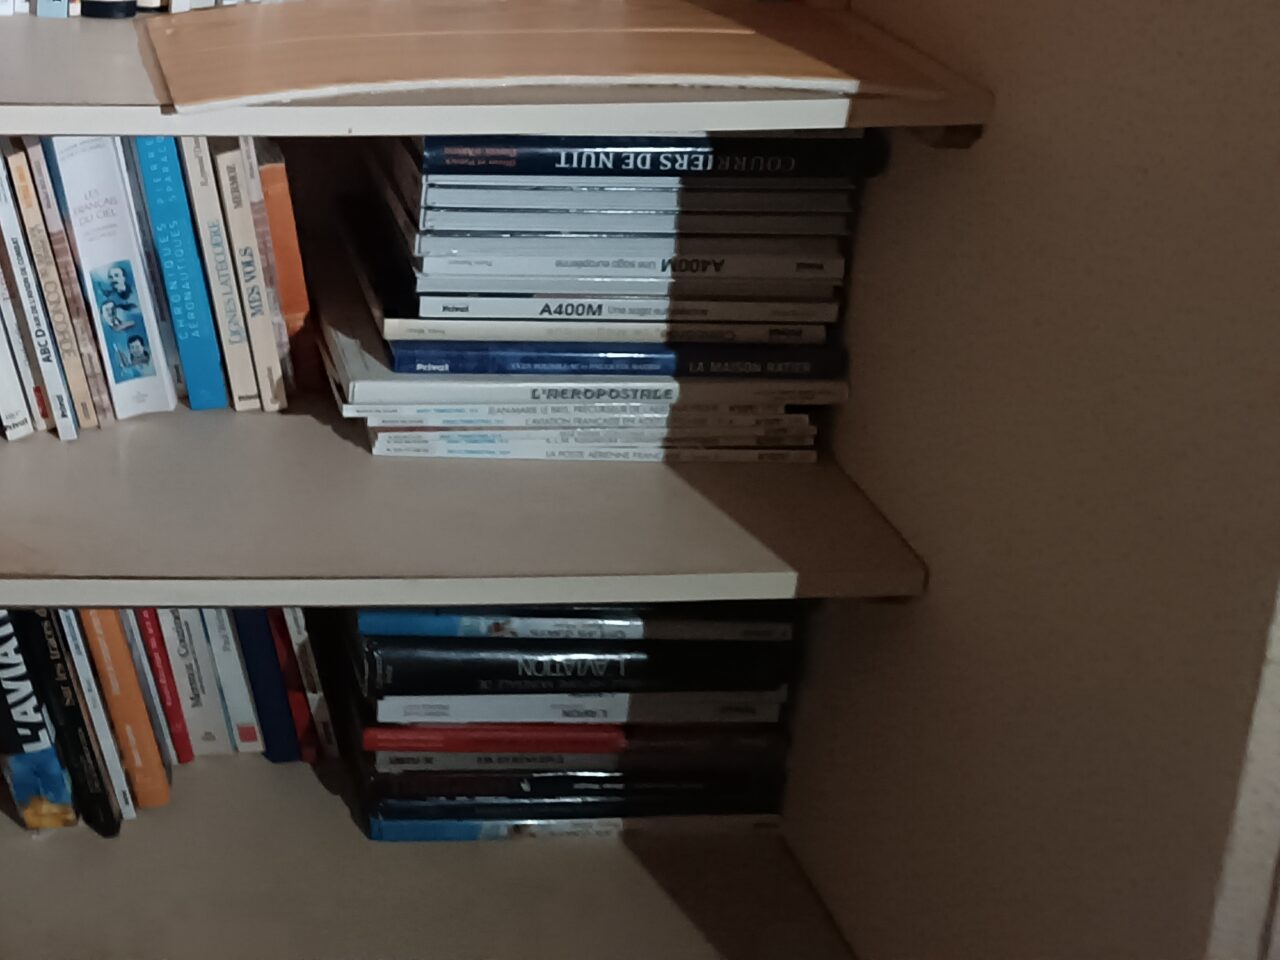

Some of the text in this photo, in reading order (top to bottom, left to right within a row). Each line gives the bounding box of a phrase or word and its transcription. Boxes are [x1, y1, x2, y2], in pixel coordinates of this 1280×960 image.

[556, 151, 614, 169] NUIT
[622, 152, 652, 170] DE
[225, 163, 243, 209] MERMOZ
[95, 207, 116, 220] CIEL
[638, 260, 655, 269] Une
[660, 257, 723, 272] A400M
[156, 223, 189, 339] CHRONIQUES
[239, 245, 264, 318] MES VOLS
[539, 301, 602, 317] A400M
[416, 363, 448, 371] Privat
[689, 361, 810, 372] LA MAISON RATIER
[531, 388, 672, 400] L'AEROPOSTALE
